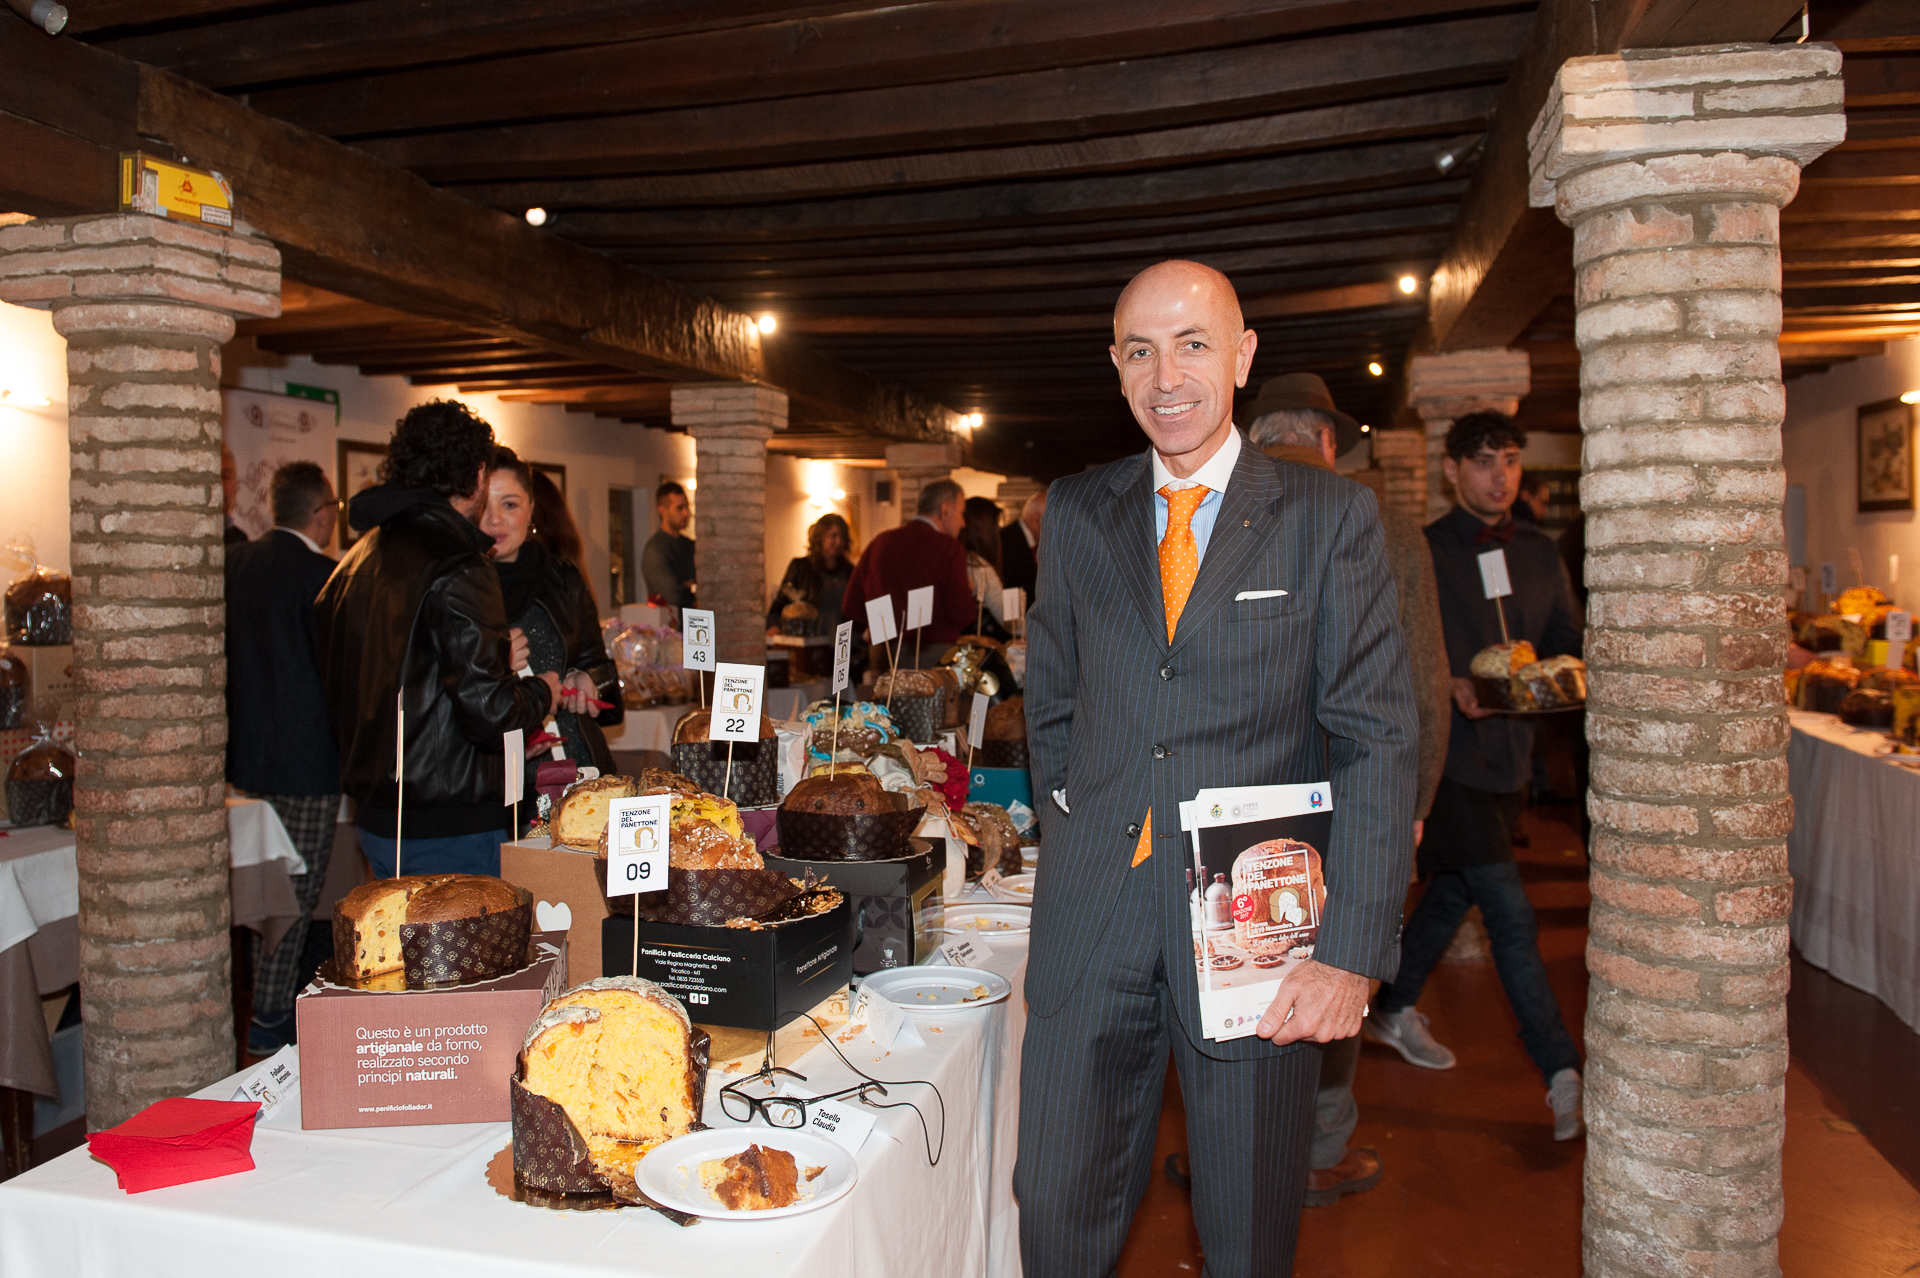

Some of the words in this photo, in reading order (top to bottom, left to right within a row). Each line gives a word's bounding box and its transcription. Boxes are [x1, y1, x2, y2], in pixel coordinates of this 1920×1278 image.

[693, 651, 705, 662] 43
[725, 719, 744, 732] 22
[621, 820, 658, 828] PANETTONE
[627, 862, 650, 880] 09
[1248, 856, 1294, 871] TENZONE
[1248, 871, 1266, 881] DEL
[1248, 874, 1306, 891] PANETTONE
[641, 948, 667, 957] Panificio
[668, 951, 701, 960] Pasticceria
[703, 954, 731, 962] Calciano
[797, 958, 817, 974] Panettone
[356, 1027, 400, 1040] Questo
[404, 1026, 412, 1037] è
[415, 1027, 430, 1037] un
[435, 1023, 488, 1039] prodotto
[356, 1040, 423, 1056] artigianale
[427, 1040, 442, 1051] da
[446, 1038, 483, 1051] forno,
[357, 1056, 414, 1069] realizzato
[418, 1053, 470, 1066] secondo
[270, 1064, 285, 1078] Follador
[358, 1070, 401, 1086] principi
[406, 1068, 458, 1081] naturali.
[358, 1103, 433, 1113] www.panificiofollador.it
[819, 1109, 841, 1123] Tosello
[812, 1117, 836, 1132] Claudia
